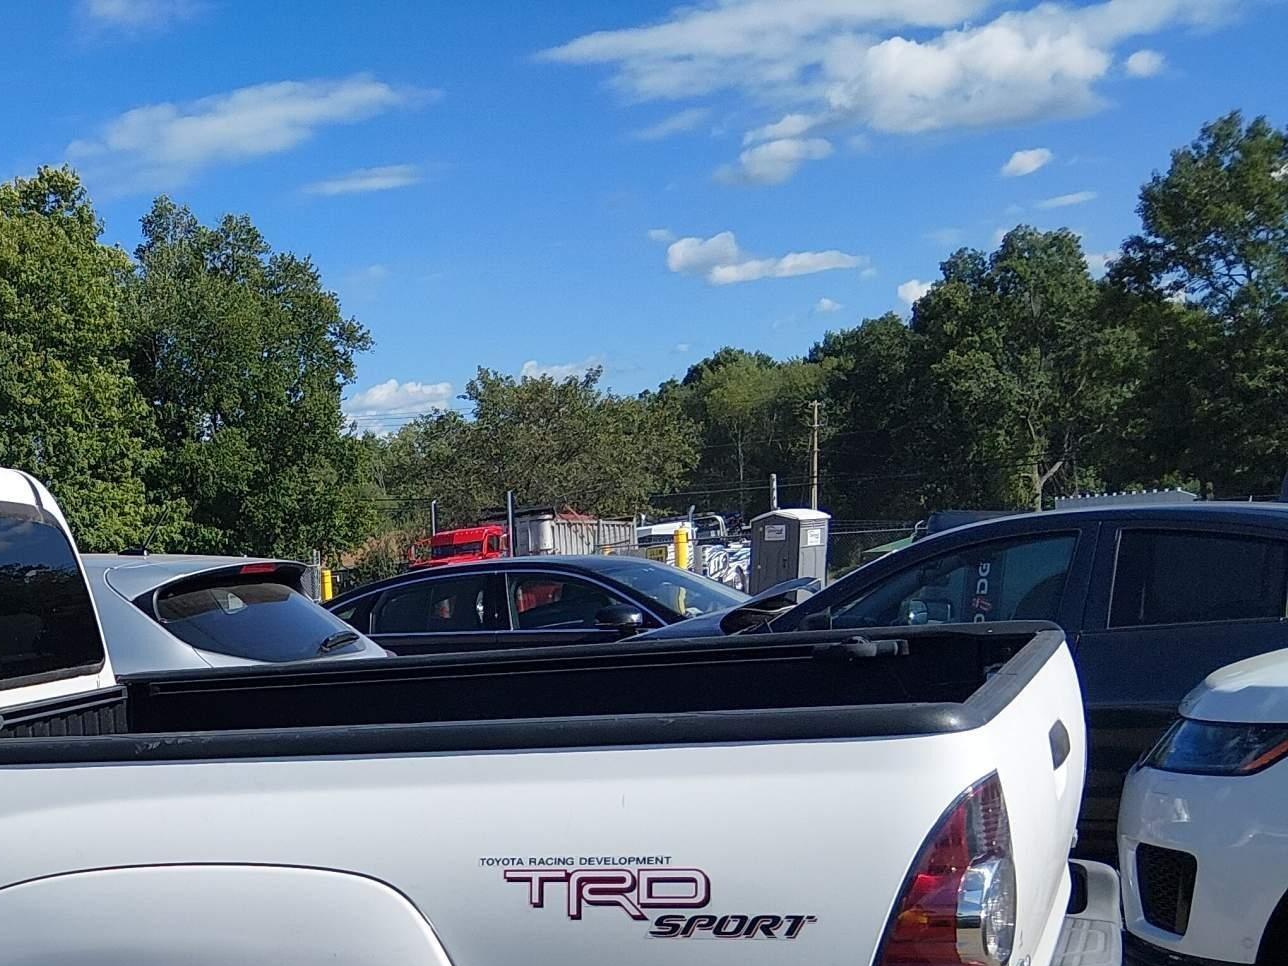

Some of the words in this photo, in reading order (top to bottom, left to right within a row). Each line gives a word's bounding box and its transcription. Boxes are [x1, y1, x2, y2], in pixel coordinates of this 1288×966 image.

[480, 857, 524, 867] TOYOTA
[528, 856, 575, 866] RACING
[579, 855, 672, 866] DEVELOPMENT
[503, 868, 711, 920] TRD
[648, 914, 818, 939] SPORT
